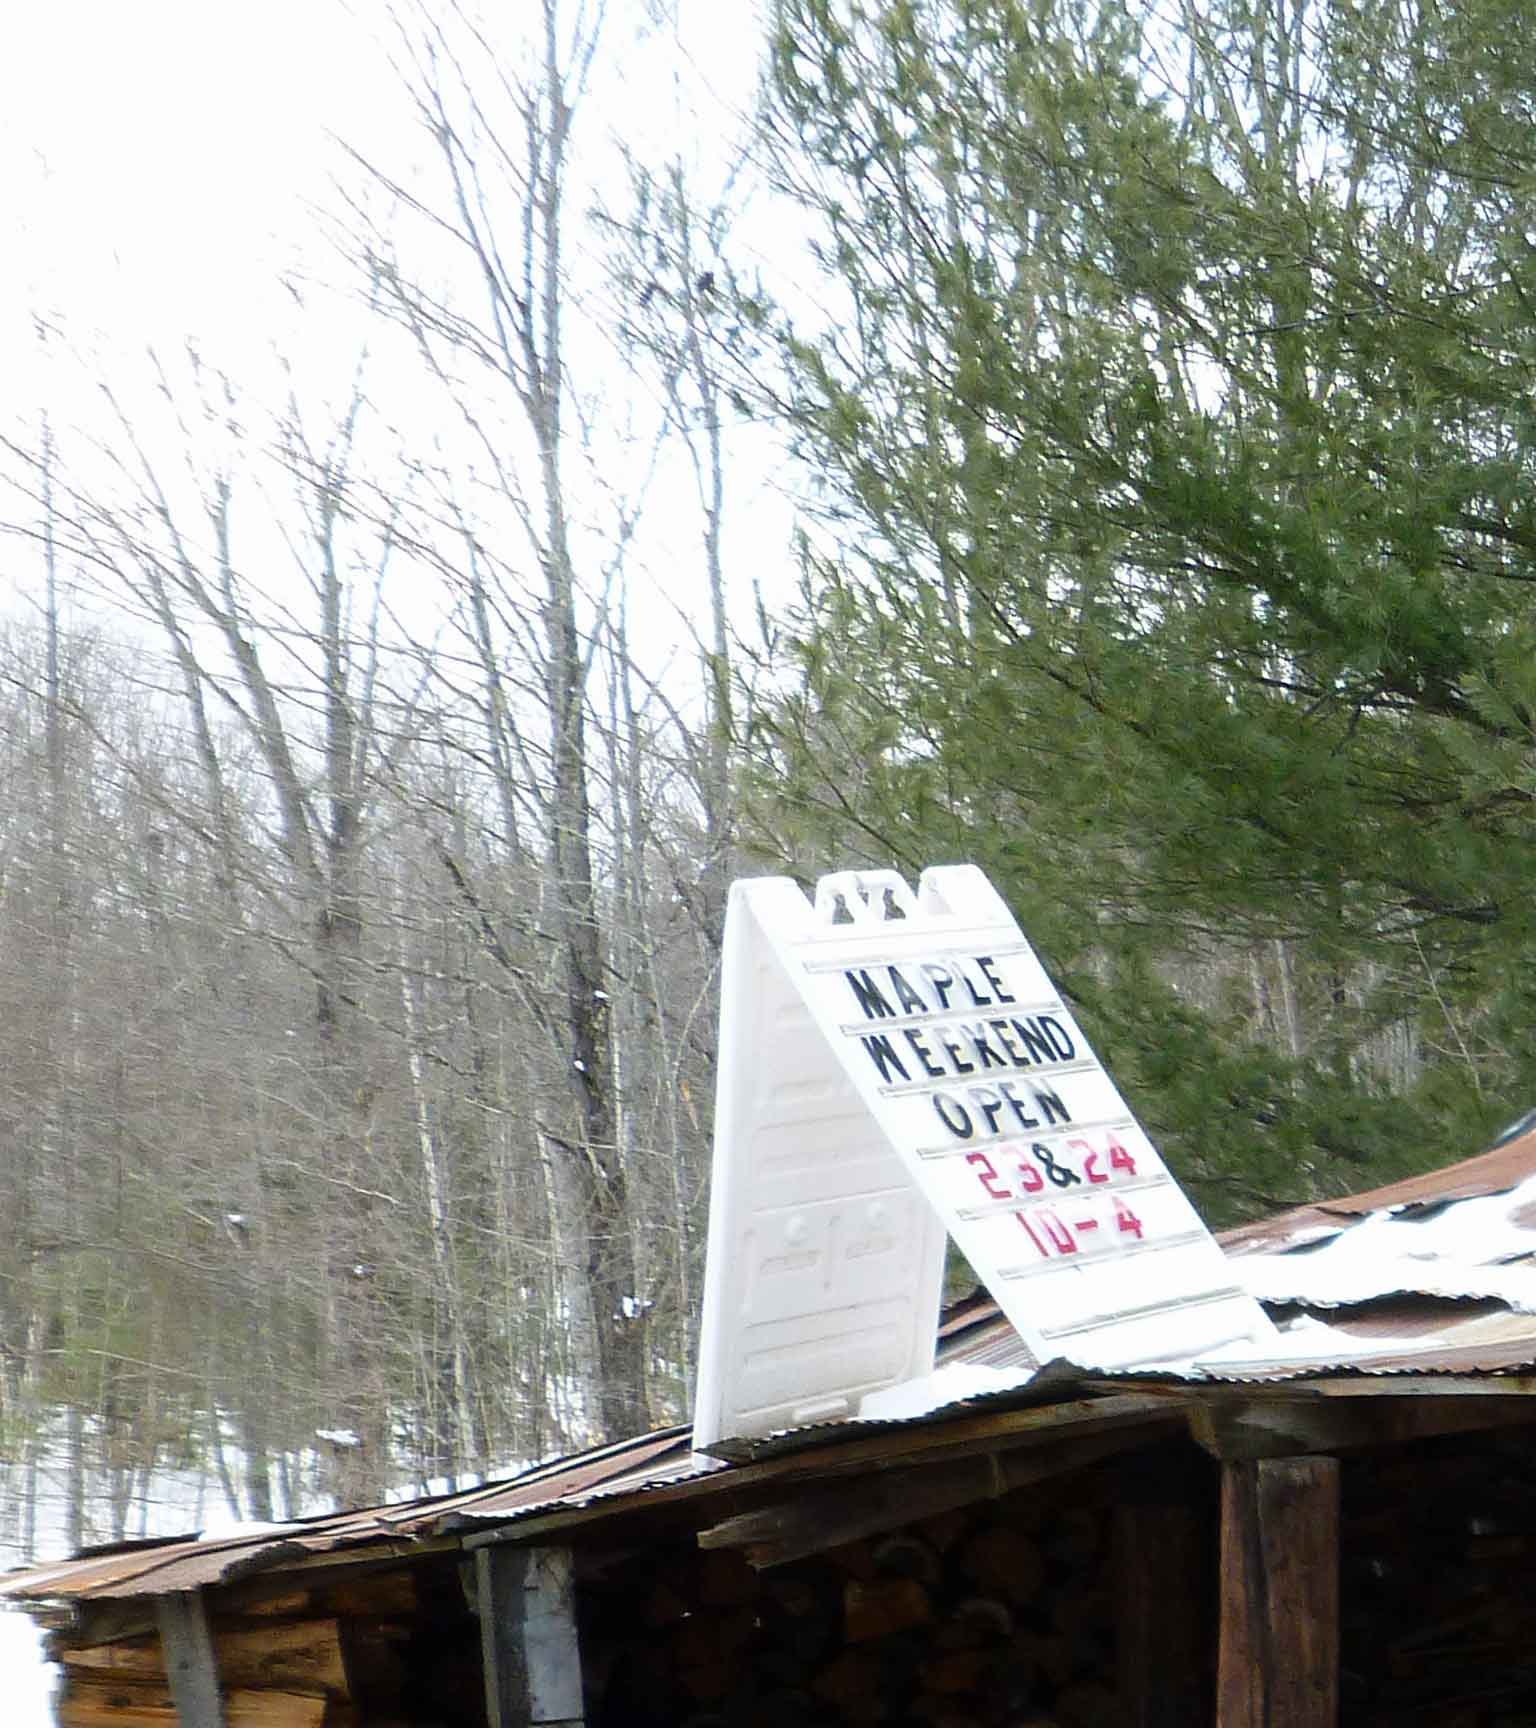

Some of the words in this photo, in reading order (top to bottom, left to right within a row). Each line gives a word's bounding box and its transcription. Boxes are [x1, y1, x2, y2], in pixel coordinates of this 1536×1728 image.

[845, 956, 1017, 1020] MAPLE
[860, 1015, 1076, 1084] WEEKEND
[932, 1078, 1073, 1139] OPEN
